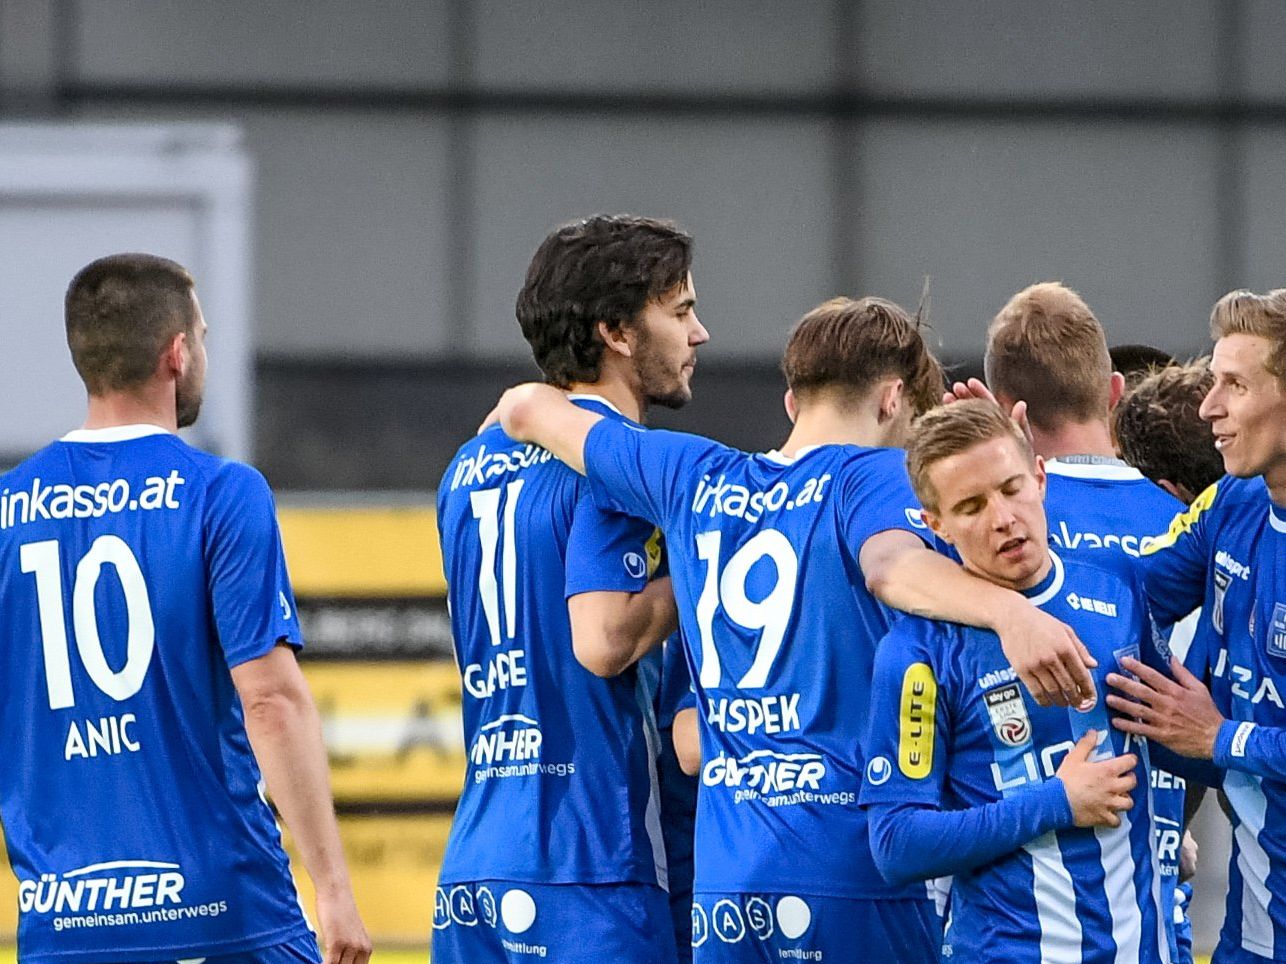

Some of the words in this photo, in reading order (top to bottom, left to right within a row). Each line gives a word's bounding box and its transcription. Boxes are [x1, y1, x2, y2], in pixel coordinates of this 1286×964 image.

[0, 470, 186, 530] inkasso.at
[470, 479, 525, 646] 11
[20, 534, 155, 711] 10
[695, 528, 798, 689] 19
[65, 713, 141, 761] ANIC
[908, 680, 926, 767] E-LITE
[19, 872, 186, 914] GÜNTHER
[53, 900, 228, 931] gemeinsam.unterwegs
